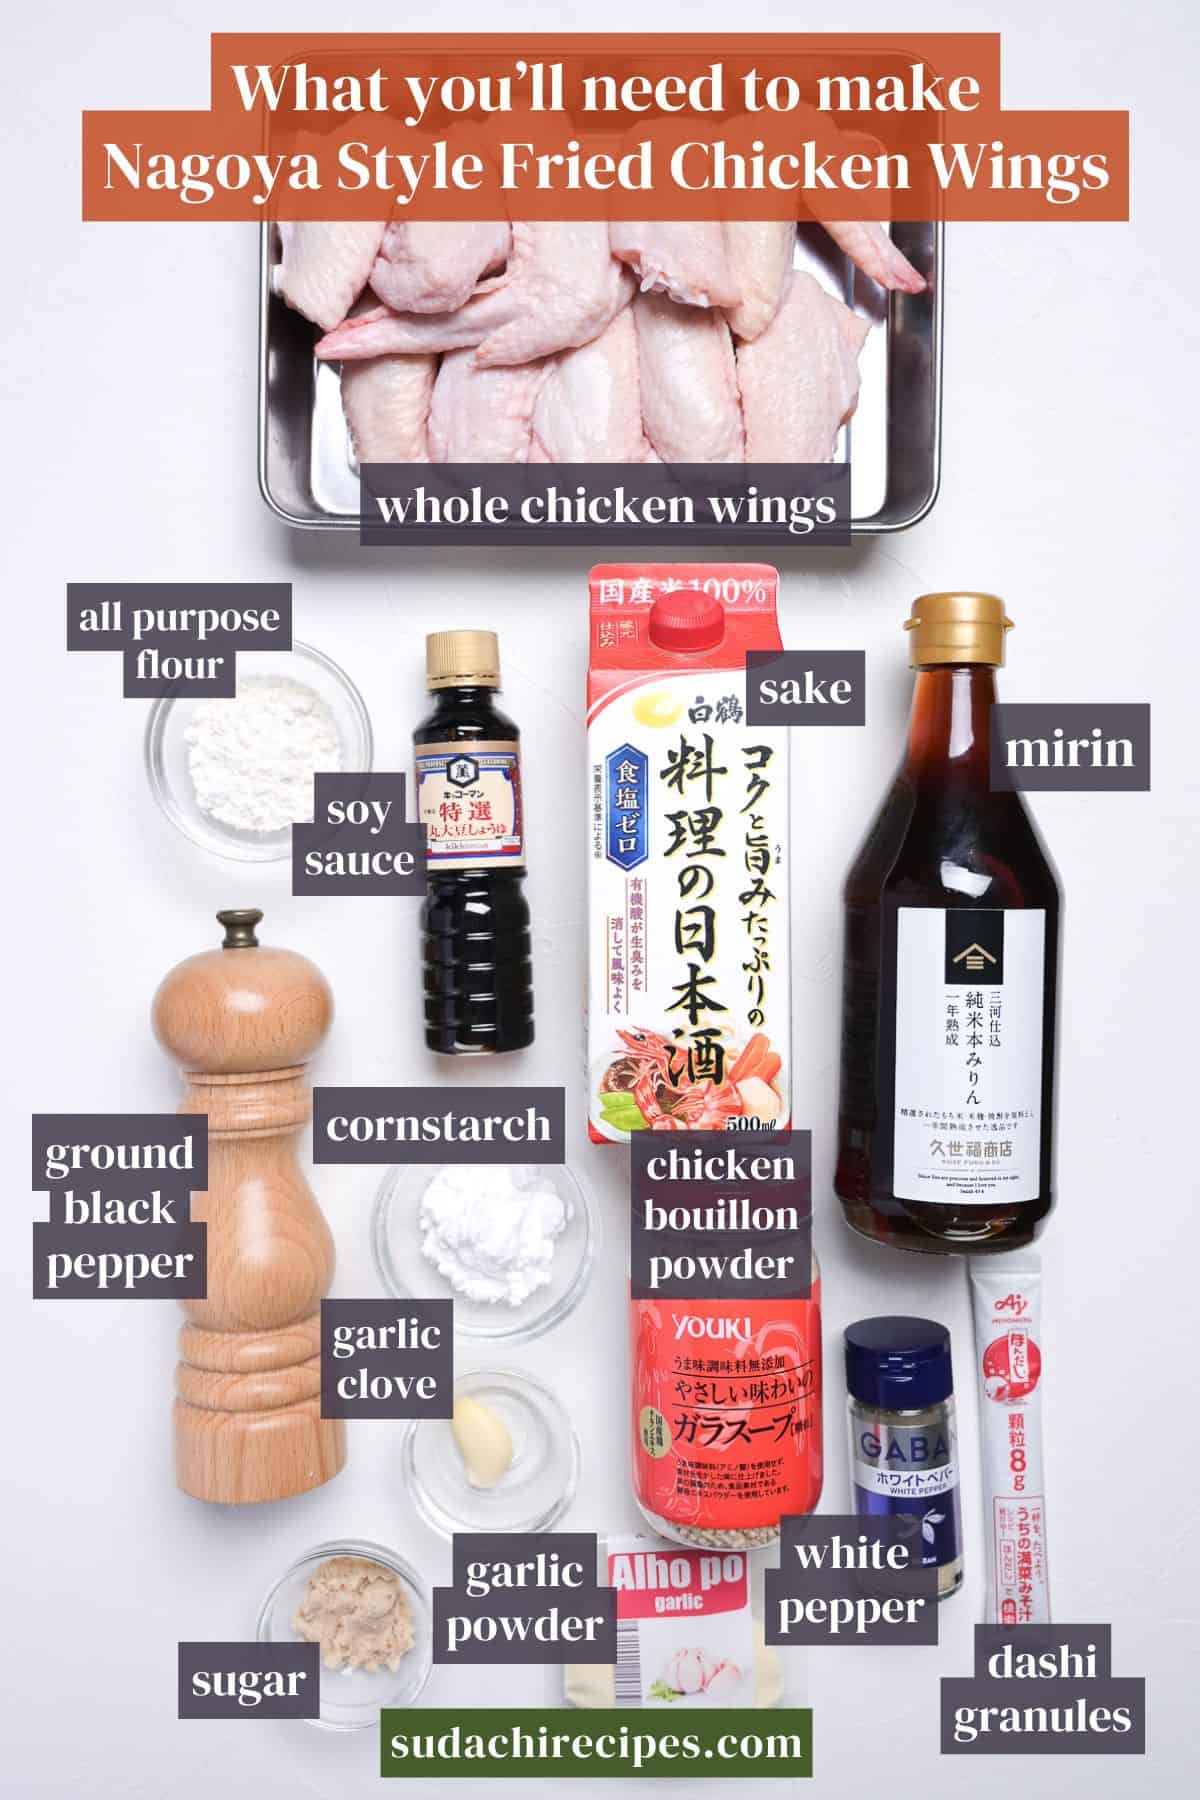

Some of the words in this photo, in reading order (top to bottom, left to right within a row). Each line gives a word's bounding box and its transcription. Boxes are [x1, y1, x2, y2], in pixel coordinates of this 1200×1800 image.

[688, 695, 744, 724] 白鶴
[440, 801, 491, 822] 特選
[615, 759, 640, 854] 食塩ゼロ
[739, 745, 776, 1027] コクと旨みたっぷりの
[659, 733, 728, 1087] 料理の日本酒
[946, 996, 960, 1046] 一年熟成
[988, 991, 1002, 1047] 三河仕込
[966, 992, 984, 1105] 純米本みりん
[929, 1139, 1013, 1158] 久世福商店
[674, 1356, 785, 1374] うま味調味料無添加
[675, 1370, 814, 1405] やさしい味わいの
[674, 1406, 797, 1447] ガラスープ
[890, 1487, 917, 1496] WHITE
[612, 1553, 692, 1591] Alho
[655, 1592, 704, 1613] garlic
